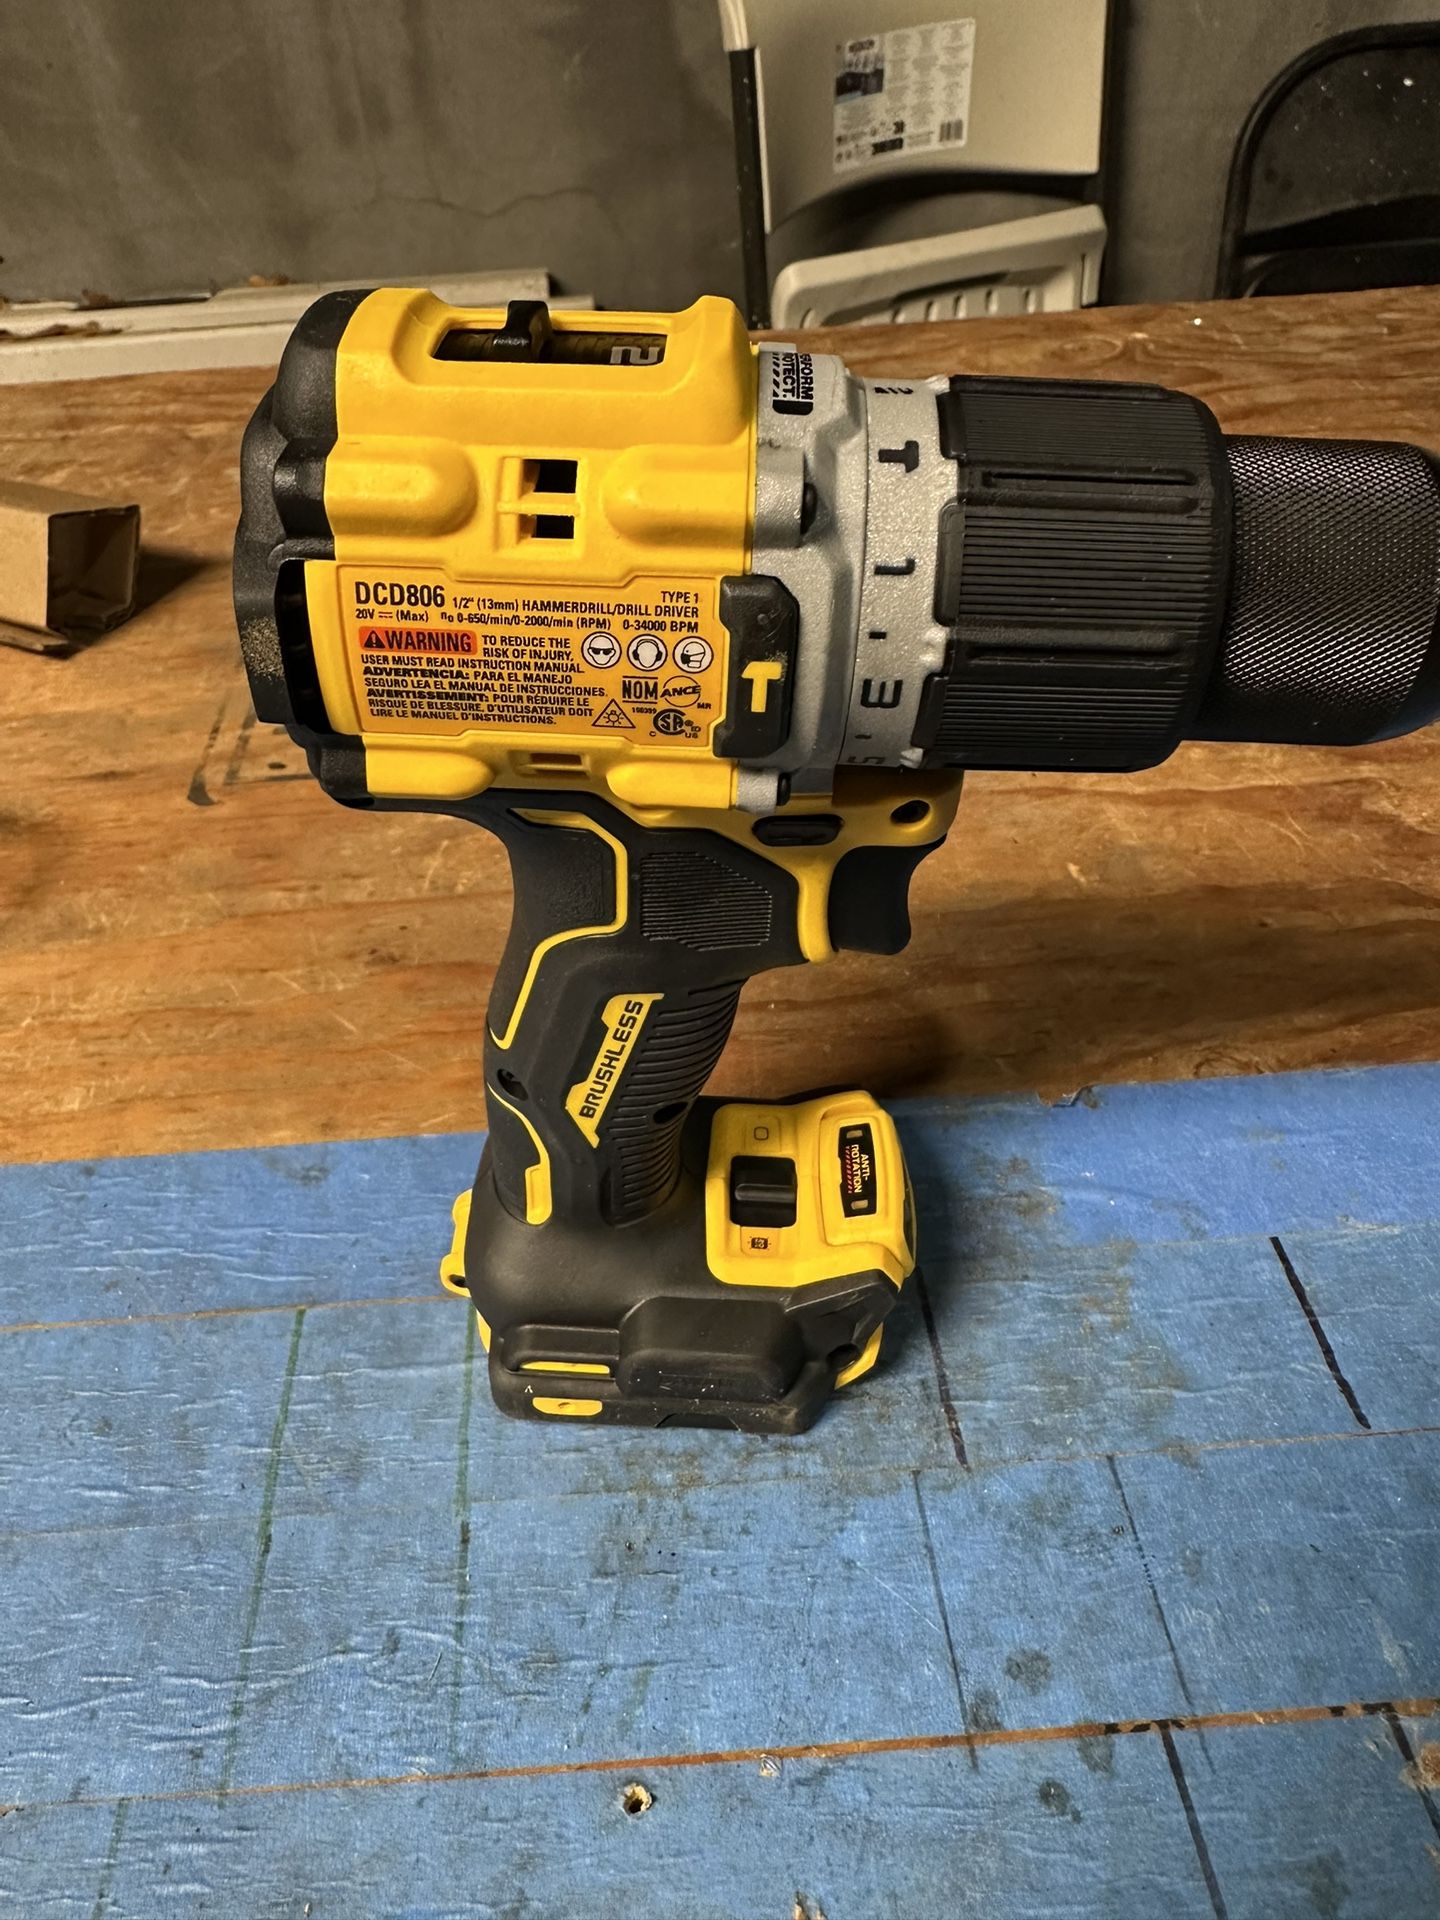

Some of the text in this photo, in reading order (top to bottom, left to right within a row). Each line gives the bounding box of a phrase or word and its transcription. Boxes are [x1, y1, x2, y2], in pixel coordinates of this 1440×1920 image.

[355, 581, 445, 608] DCD806
[477, 598, 519, 612] (13mm)
[522, 600, 652, 616] HAMMERDRILL/DRILL
[654, 605, 699, 618] DRIVER
[660, 591, 699, 604] TYPE 1
[355, 609, 375, 619] 20V
[396, 610, 429, 623] (Max)
[576, 617, 611, 630] (RPM)
[622, 619, 666, 632] 0-34000
[670, 620, 698, 633] BPM
[385, 630, 472, 653] WARNING
[481, 635, 571, 649] TO REDUCE THE
[361, 654, 389, 665] USER
[392, 655, 424, 667] MUST
[426, 657, 455, 668] READ
[458, 658, 531, 671] INSTRUCTION
[482, 648, 574, 661] RISK OF INJURY,
[363, 666, 573, 684] ADVERTENCIA: PARA EL MANEJO
[364, 677, 408, 688] SEGURO
[411, 679, 431, 689] LEA
[434, 680, 445, 690] EL
[448, 681, 498, 692] MANUAL
[500, 683, 514, 693] DE
[622, 679, 659, 700] NOM
[660, 685, 701, 698] ANCE
[367, 688, 489, 702] AVERTISSEMENT:
[493, 693, 524, 704] POUR
[577, 697, 589, 707] LE
[368, 698, 407, 709] RISQUE
[410, 700, 425, 710] DE
[569, 707, 594, 717] DOIT
[370, 708, 393, 717] LIRE
[396, 709, 408, 718] LE
[411, 711, 459, 720] MANUEL
[578, 1000, 644, 1119] BRUSHLESS
[851, 1144, 863, 1193] ROTATION
[860, 1153, 870, 1181] ANTI-
